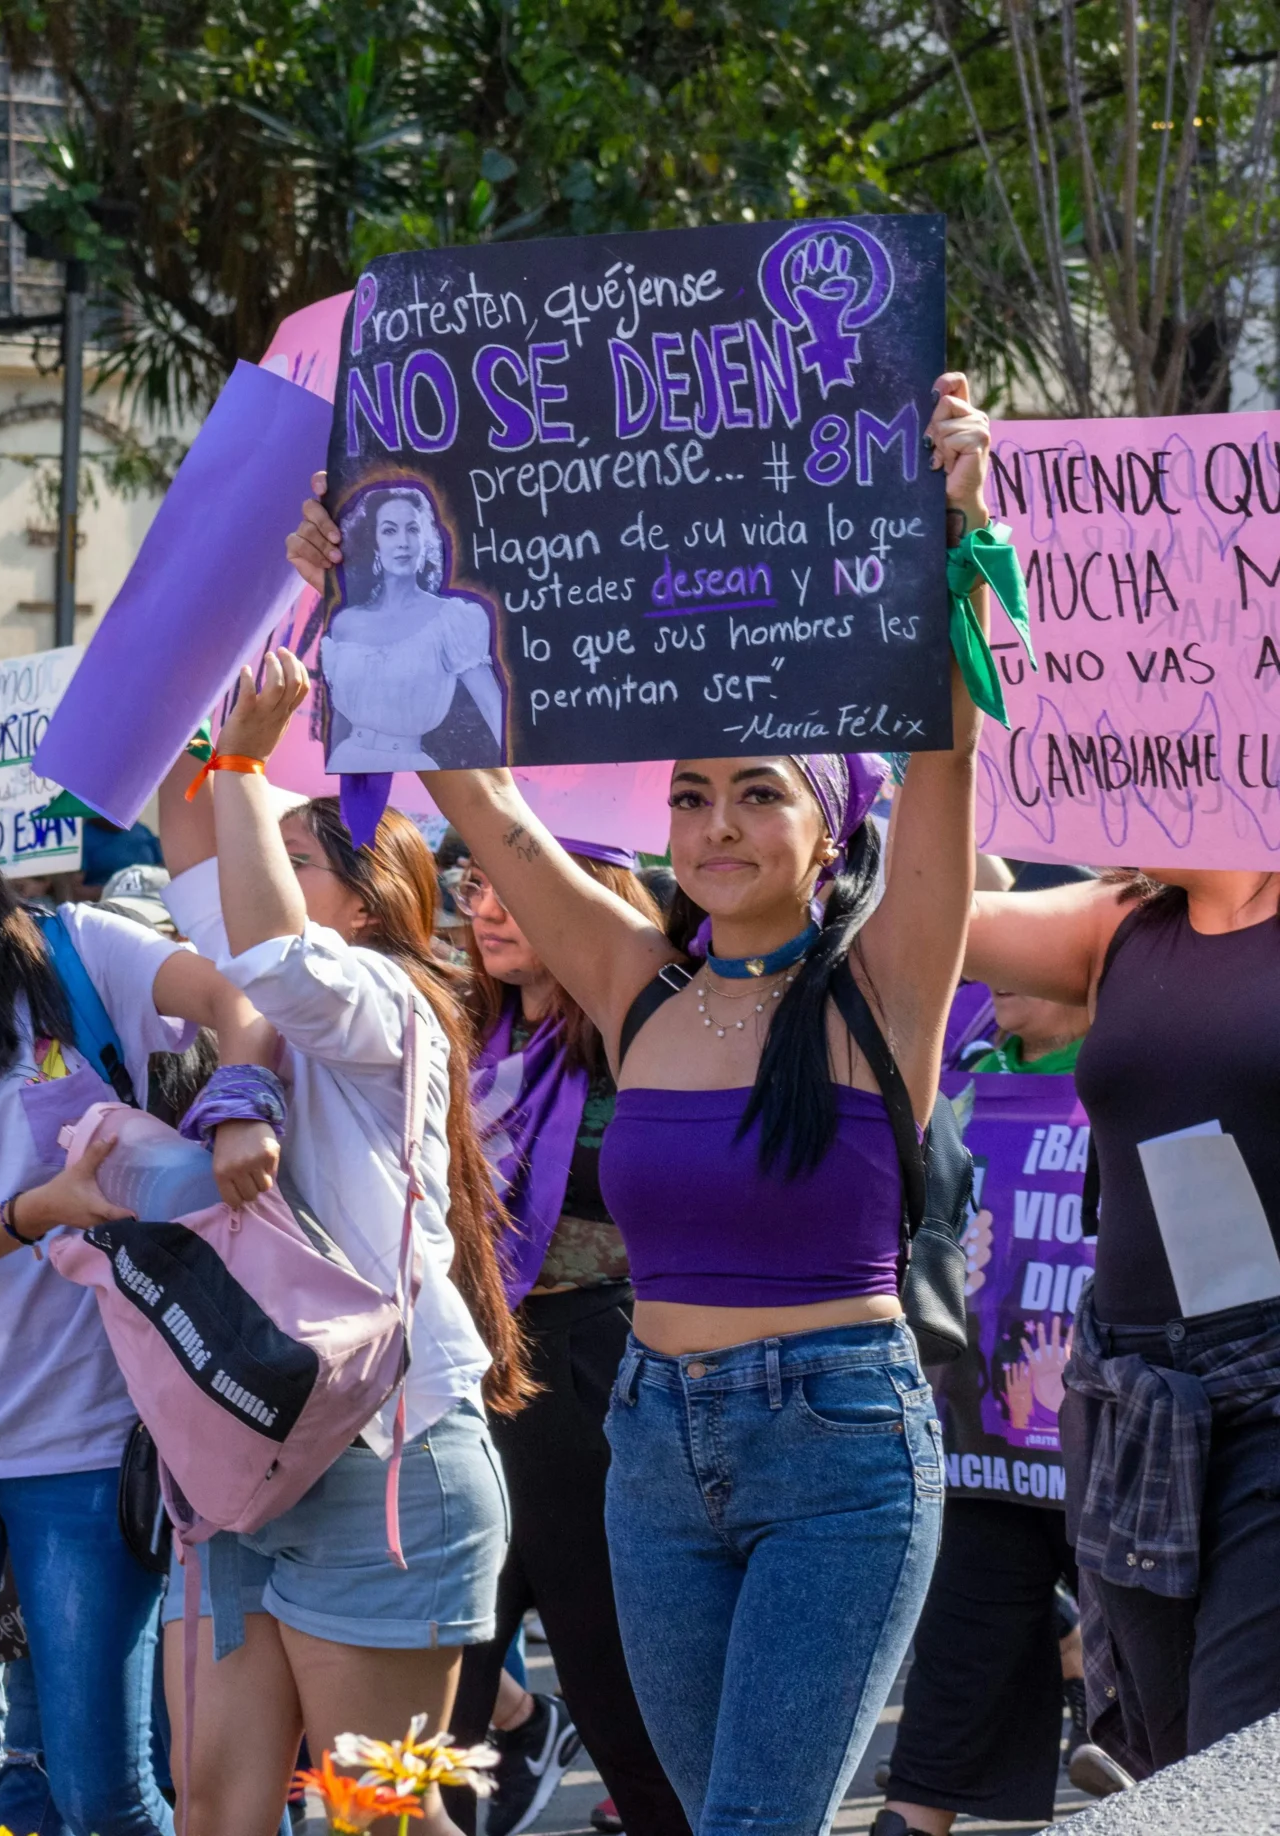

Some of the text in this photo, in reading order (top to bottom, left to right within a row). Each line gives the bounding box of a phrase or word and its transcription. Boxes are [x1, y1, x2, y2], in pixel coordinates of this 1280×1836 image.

[346, 348, 460, 458] NO
[472, 339, 576, 453] SE
[609, 316, 801, 440] DEJEN
[989, 447, 1181, 519] NTIENDE
[473, 502, 926, 581] Hagan de su vida lo que
[504, 572, 636, 613] ustedes
[651, 555, 773, 606] desean
[833, 554, 885, 597] NO
[522, 603, 920, 672] lo que sus hombres les
[1046, 649, 1105, 683] NO
[1127, 643, 1216, 684] VAS
[529, 673, 678, 725] permitan
[836, 705, 926, 738] Félix
[1009, 726, 1220, 807] CAMBIARME
[1022, 1124, 1091, 1175] ¡BA
[1014, 1190, 1098, 1244] VIO
